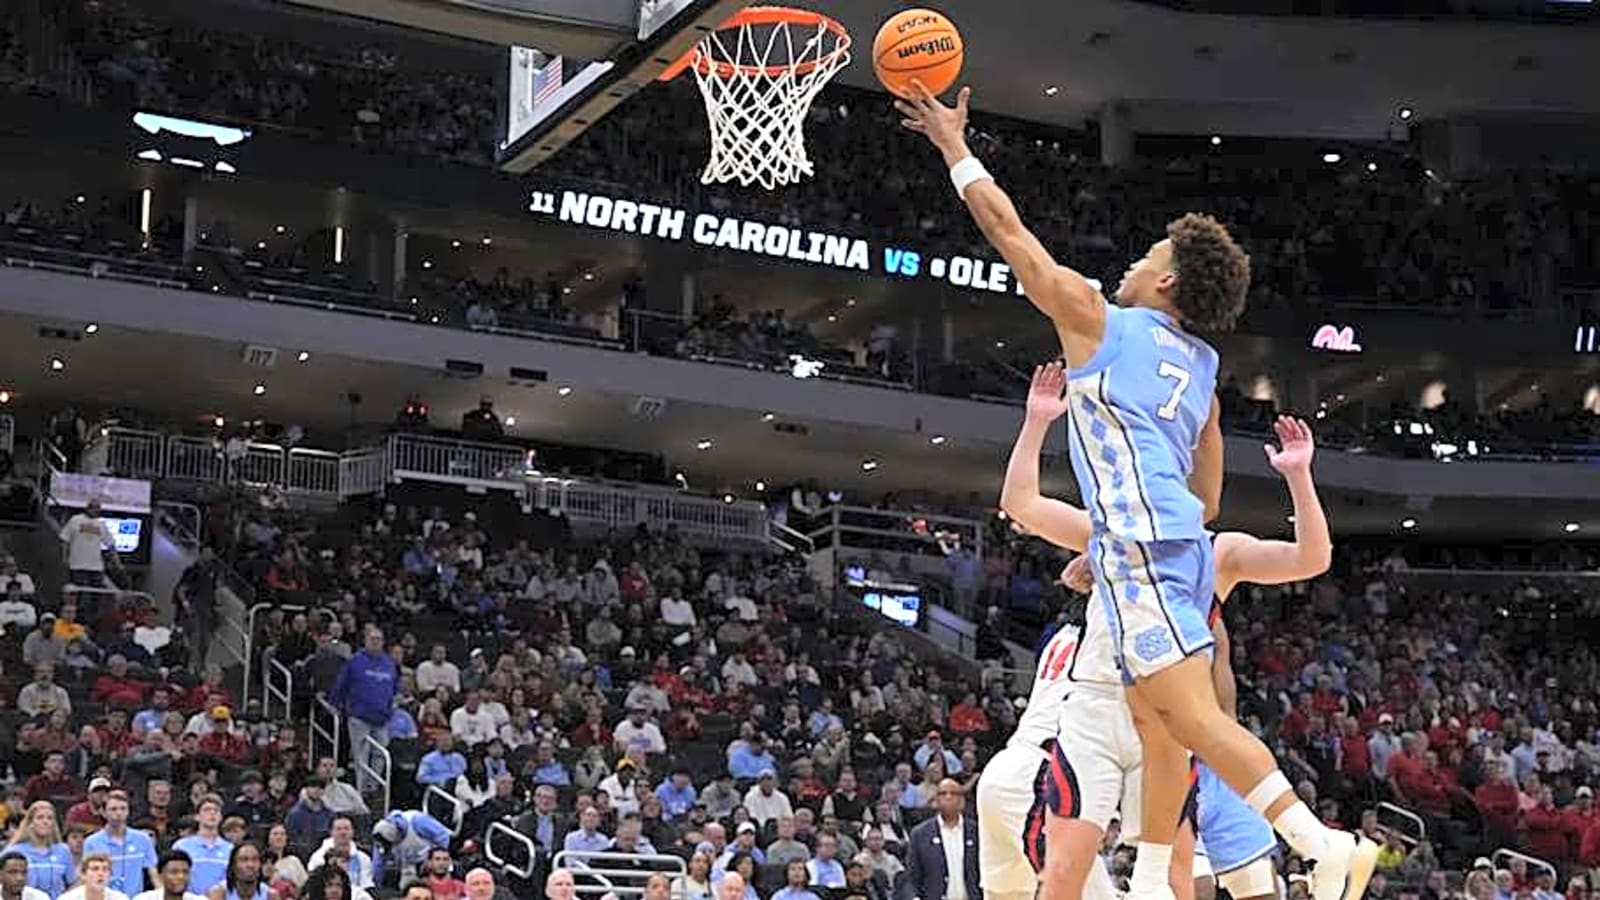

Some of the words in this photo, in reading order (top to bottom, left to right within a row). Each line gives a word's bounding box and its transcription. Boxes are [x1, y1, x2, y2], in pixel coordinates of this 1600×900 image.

[896, 36, 955, 58] Wilson
[529, 191, 555, 213] 11
[559, 190, 686, 239] NORTH
[692, 213, 870, 270] CAROLINA
[884, 247, 920, 277] VS
[948, 255, 1010, 293] OLE
[1156, 359, 1191, 422] 7
[1039, 638, 1076, 682] 14
